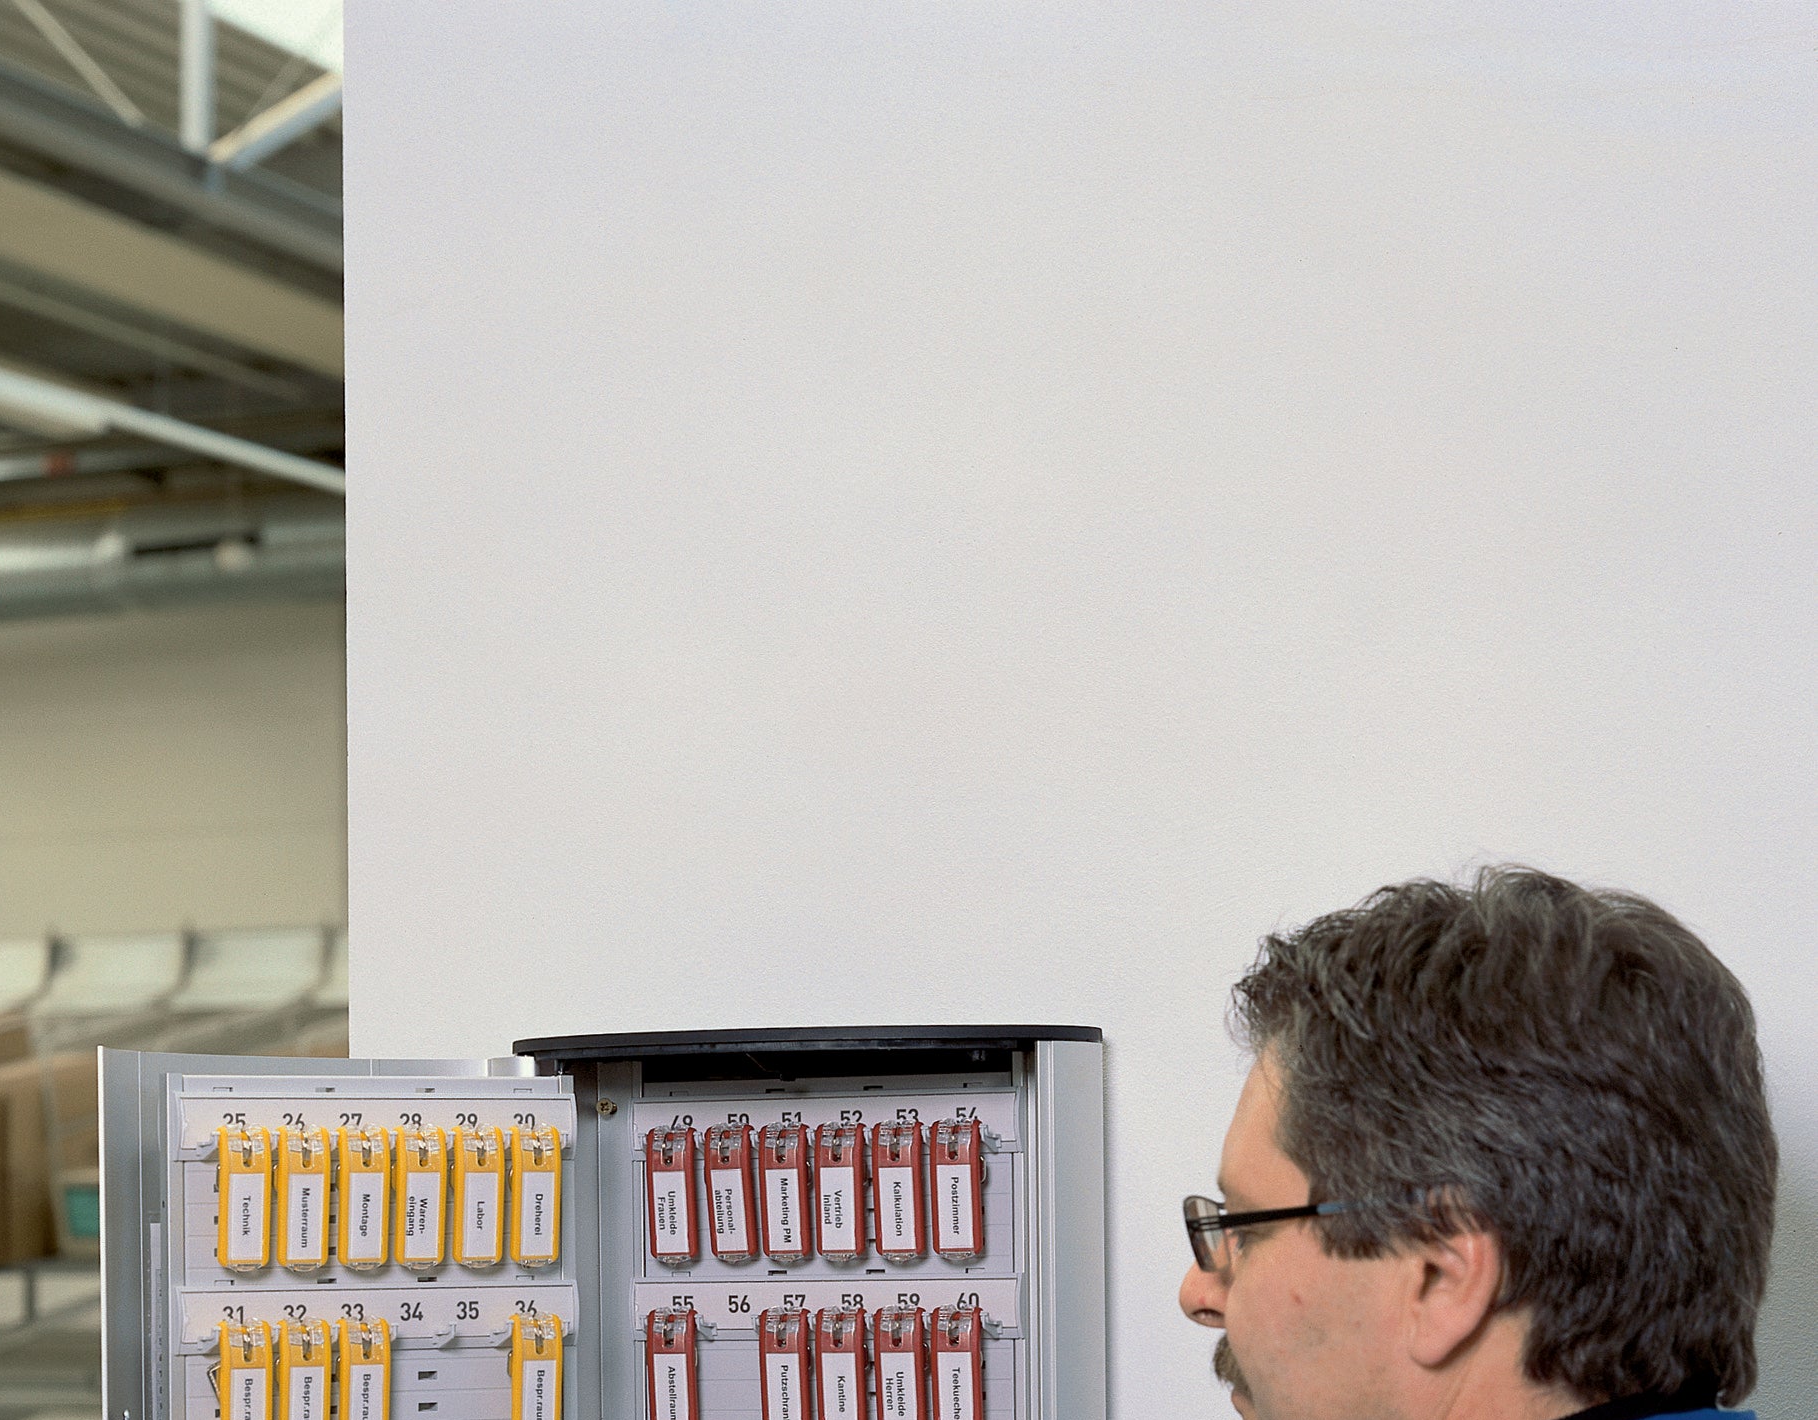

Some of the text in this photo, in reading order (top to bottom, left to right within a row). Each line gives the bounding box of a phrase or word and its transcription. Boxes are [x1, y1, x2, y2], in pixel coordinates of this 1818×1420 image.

[241, 1195, 252, 1236] Technik
[301, 1187, 311, 1249] Musterraum
[359, 1193, 371, 1237] Montage
[405, 1195, 417, 1237] eingang
[418, 1198, 428, 1234] Waren-
[476, 1200, 486, 1230] Labor
[534, 1193, 544, 1236] Dreherei
[657, 1196, 666, 1231] Frauen
[667, 1190, 678, 1236] Umkleide
[714, 1189, 725, 1235] abteilung
[724, 1188, 736, 1235] Personal-
[779, 1177, 792, 1244] Marketing PM
[823, 1194, 833, 1225] Inland
[833, 1189, 844, 1229] Vertrieb
[893, 1181, 904, 1237] Kalkulation
[950, 1176, 961, 1235] Postzimmer
[400, 1302, 424, 1321] 34
[456, 1301, 480, 1320] 35
[728, 1295, 751, 1313] 56
[783, 1294, 806, 1312] 57
[837, 1375, 847, 1413] Kantine
[885, 1377, 895, 1411] Herren
[895, 1371, 907, 1417] Umkleide
[951, 1367, 962, 1420] Teekueche
